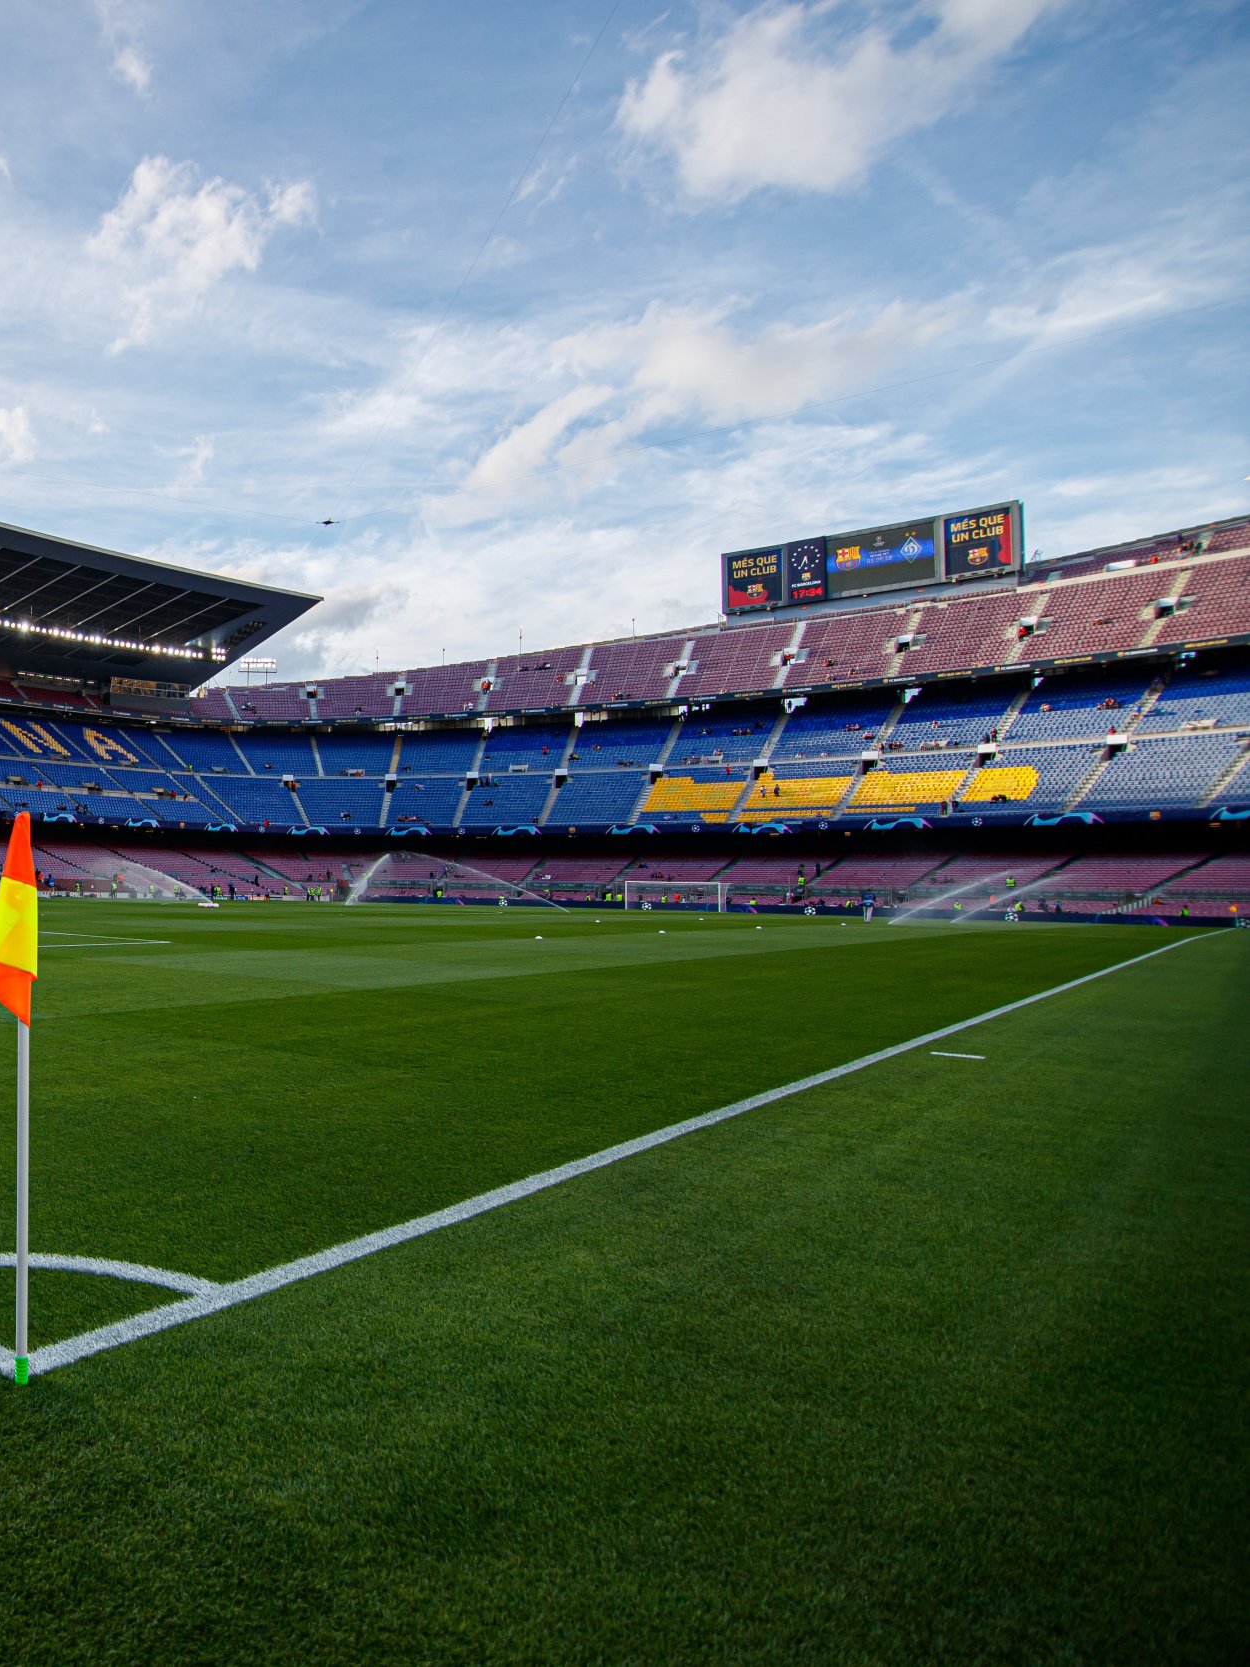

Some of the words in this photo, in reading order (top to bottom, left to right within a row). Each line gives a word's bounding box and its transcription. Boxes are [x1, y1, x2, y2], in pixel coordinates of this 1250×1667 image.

[950, 518, 976, 533] MÉS
[979, 514, 1005, 529] QUE
[951, 531, 969, 544] UN
[972, 525, 1004, 540] CLUB
[732, 557, 754, 569] MÉS
[756, 555, 778, 566] QUE
[733, 569, 748, 579] UN
[750, 565, 777, 577] CLUB
[792, 587, 823, 599] 17:34
